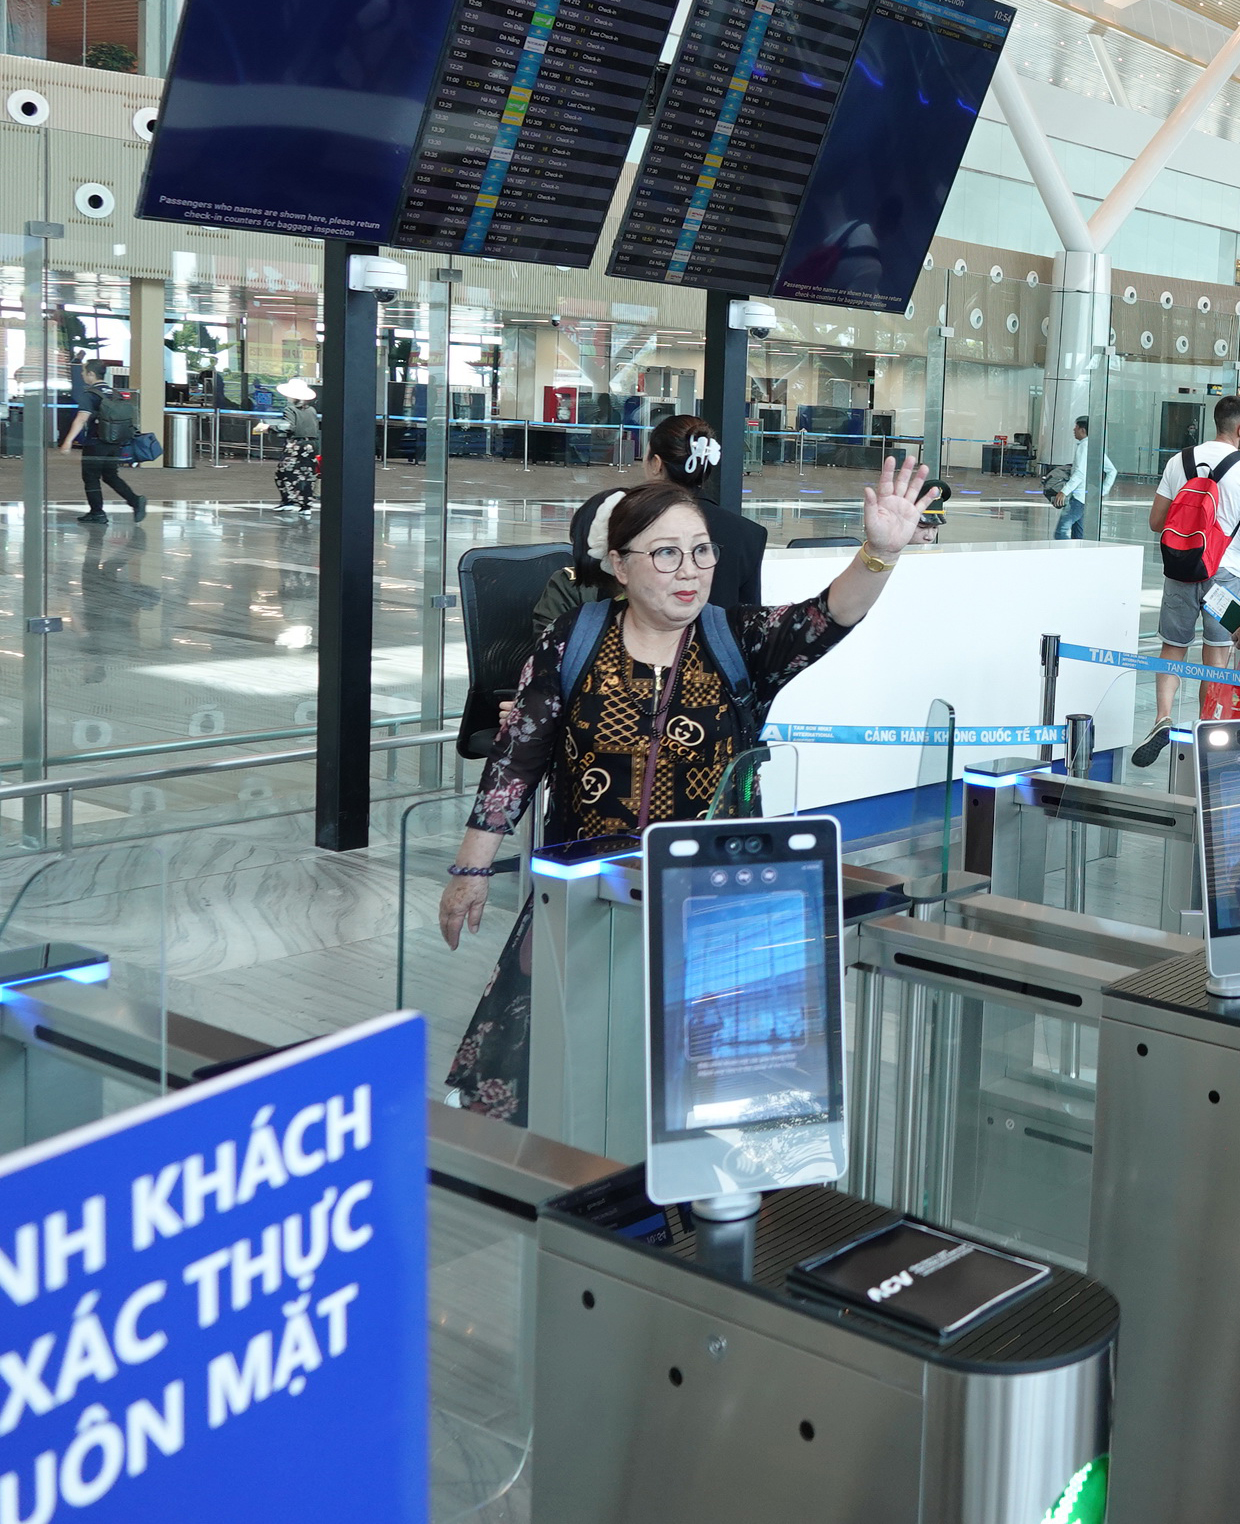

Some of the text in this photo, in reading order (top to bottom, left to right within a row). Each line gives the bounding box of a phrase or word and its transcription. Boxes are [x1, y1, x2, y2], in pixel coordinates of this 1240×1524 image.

[994, 10, 1012, 22] 10:54
[159, 196, 380, 229] Passengers who names are shown here, please return
[184, 210, 354, 237] check-in counters for baggage inspection
[783, 281, 811, 290] Passengers
[845, 297, 863, 305] baggage
[864, 299, 887, 307] inspection
[1089, 649, 1114, 663] TIA
[1167, 662, 1184, 672] TAN
[1186, 666, 1204, 676] SON
[1206, 668, 1230, 680] NHAT
[865, 727, 896, 742] CẢNG
[901, 727, 929, 742] HÀNG
[981, 726, 1011, 743] QUỐC
[1016, 727, 1030, 741] TẾ
[1035, 725, 1057, 741] TÂN
[132, 1084, 372, 1251] KHÁCH
[0, 1180, 373, 1436] XÁC THỰC
[208, 1282, 358, 1428] MẶT
